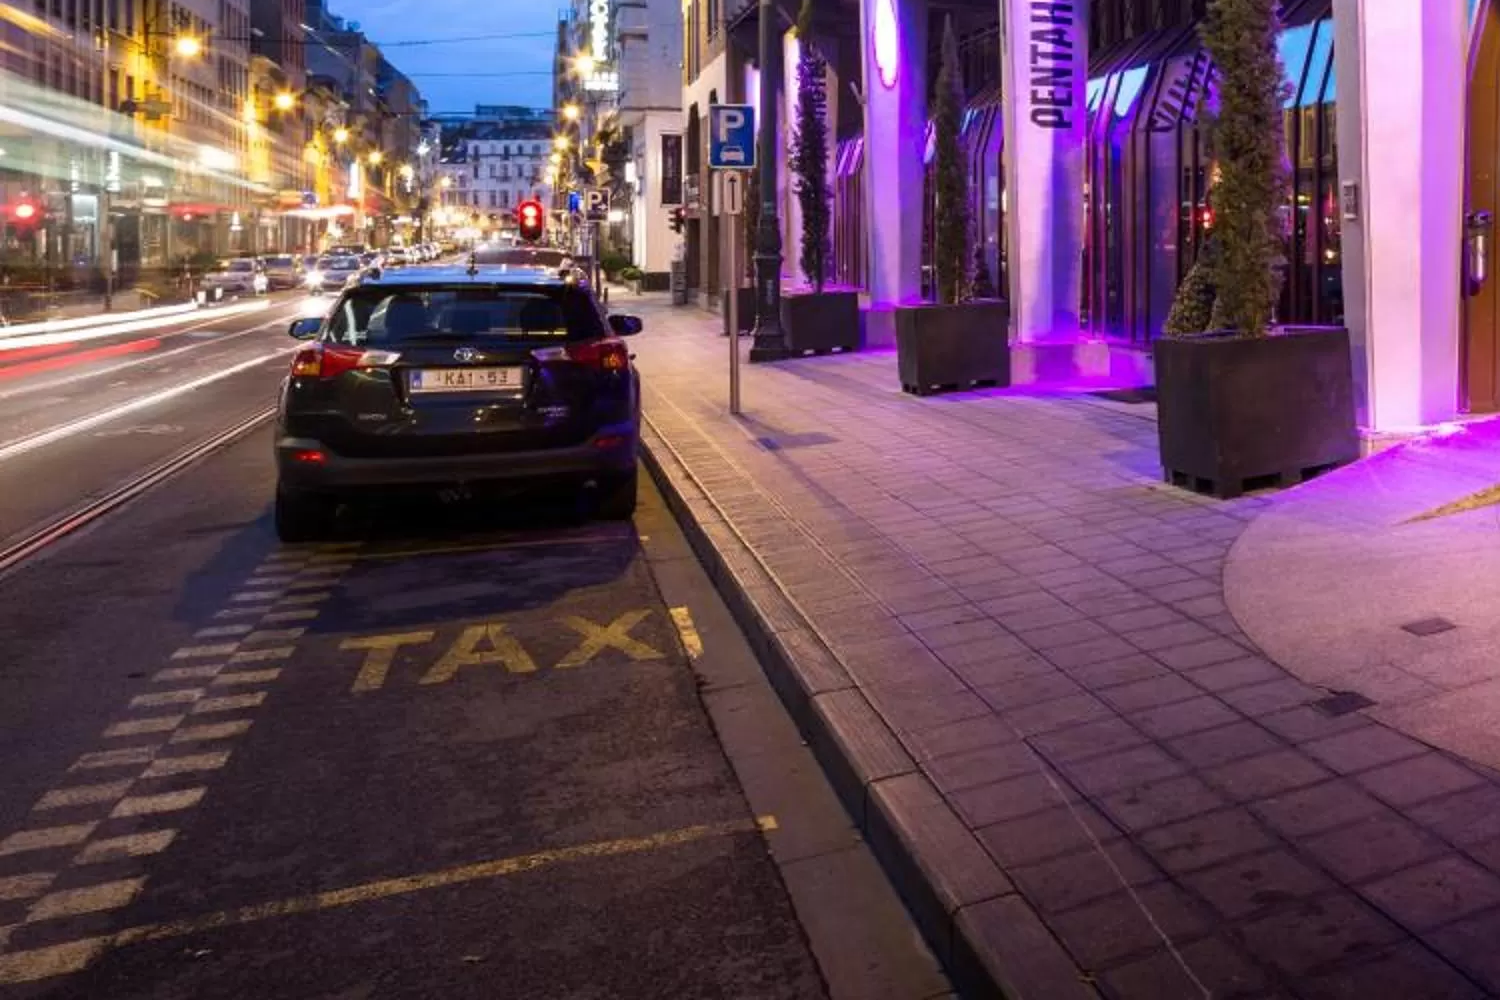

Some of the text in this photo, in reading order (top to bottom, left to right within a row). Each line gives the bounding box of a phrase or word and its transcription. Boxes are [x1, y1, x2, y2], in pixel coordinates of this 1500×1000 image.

[720, 110, 744, 142] P
[587, 191, 602, 210] P
[338, 606, 704, 693] TAXI
